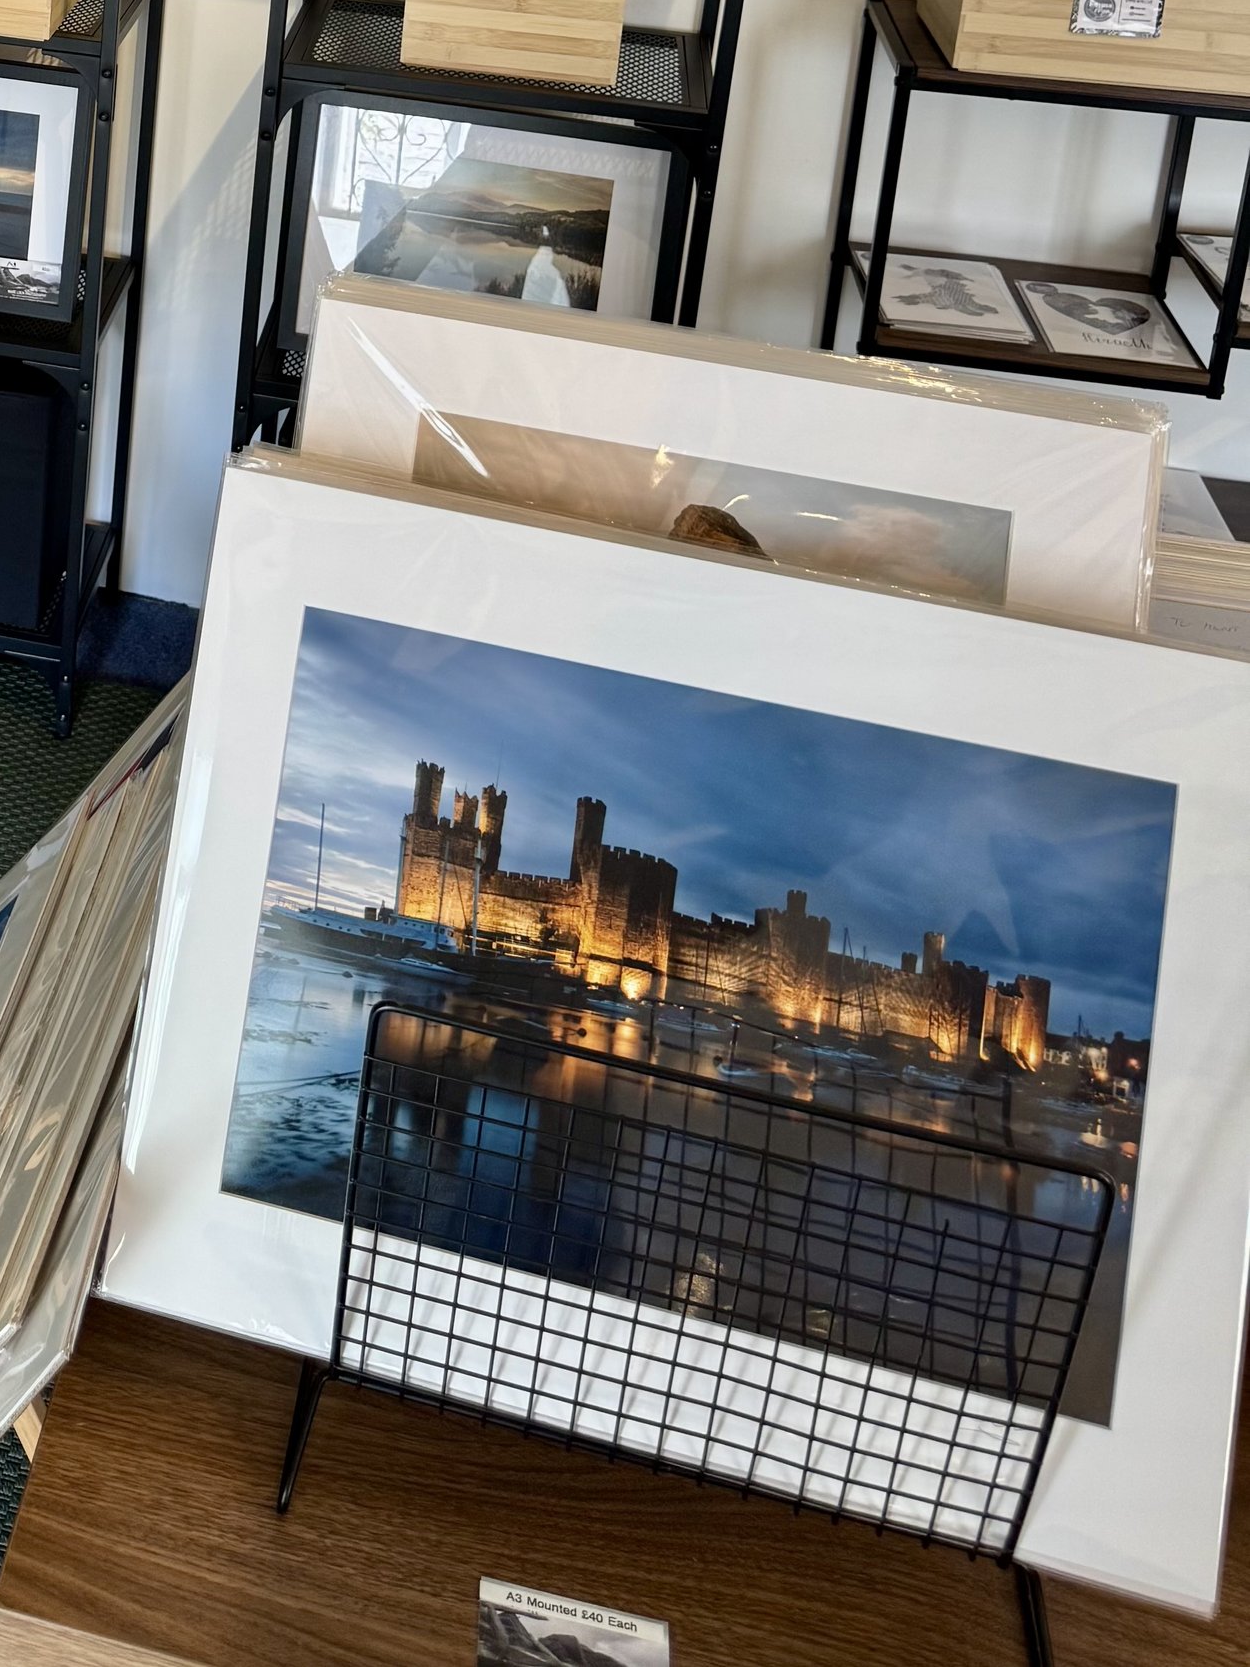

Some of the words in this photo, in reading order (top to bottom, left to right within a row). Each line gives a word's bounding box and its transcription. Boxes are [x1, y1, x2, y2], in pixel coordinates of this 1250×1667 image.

[506, 1591, 522, 1603] A3
[526, 1596, 577, 1617] Mounted
[581, 1610, 603, 1623] £40
[608, 1616, 638, 1632] Each
